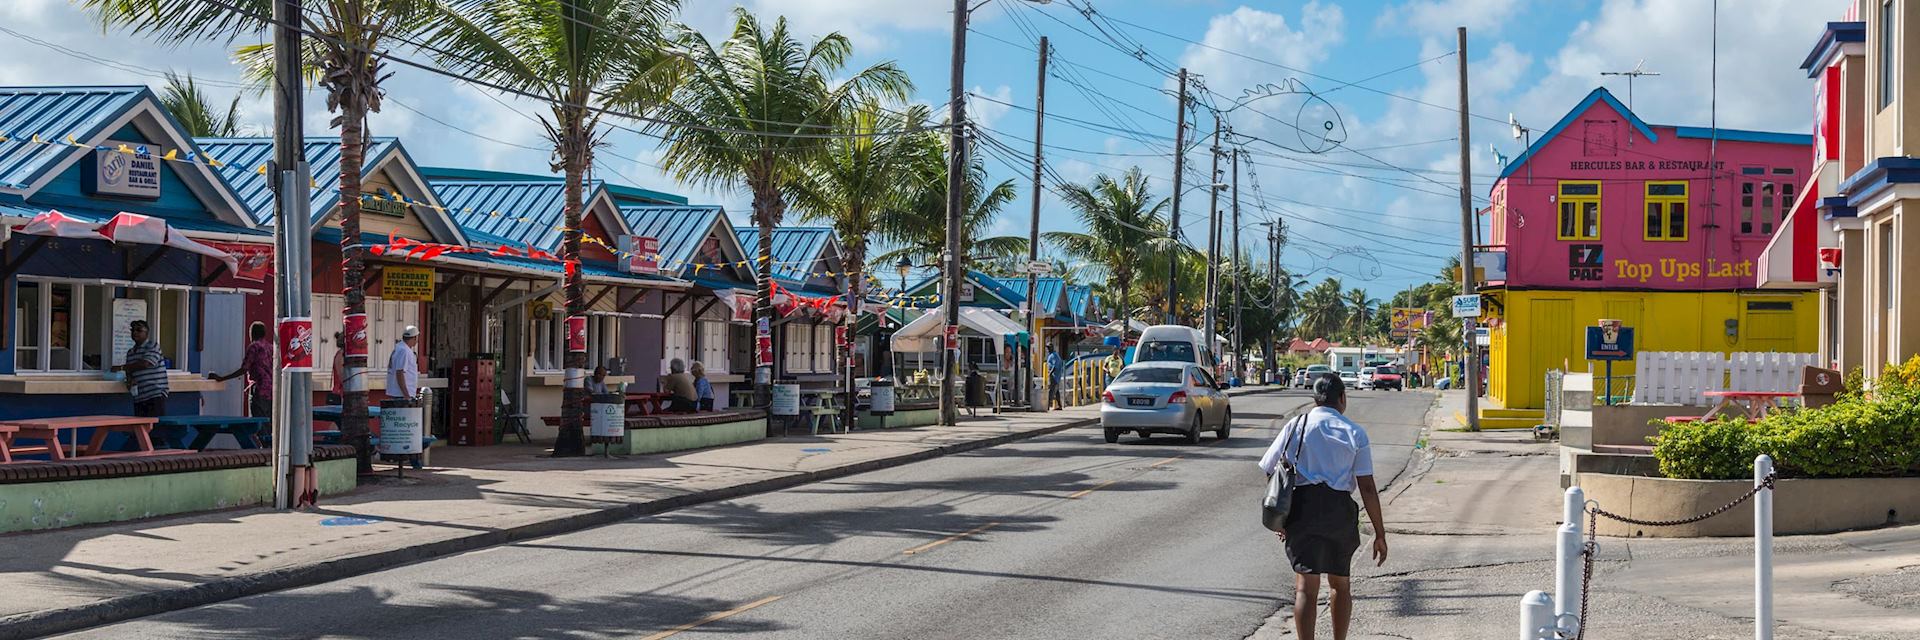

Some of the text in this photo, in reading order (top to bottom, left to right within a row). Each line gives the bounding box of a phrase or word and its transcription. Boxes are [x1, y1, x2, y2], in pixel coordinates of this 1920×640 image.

[131, 161, 154, 169] DANIEL
[1570, 160, 1725, 170] HERCULES BAR & RESTAURANT
[129, 170, 157, 178] RESTAURANT
[144, 177, 157, 185] GRILL
[1614, 258, 1753, 282] Top Ups Last
[387, 272, 429, 280] LEGENDARY
